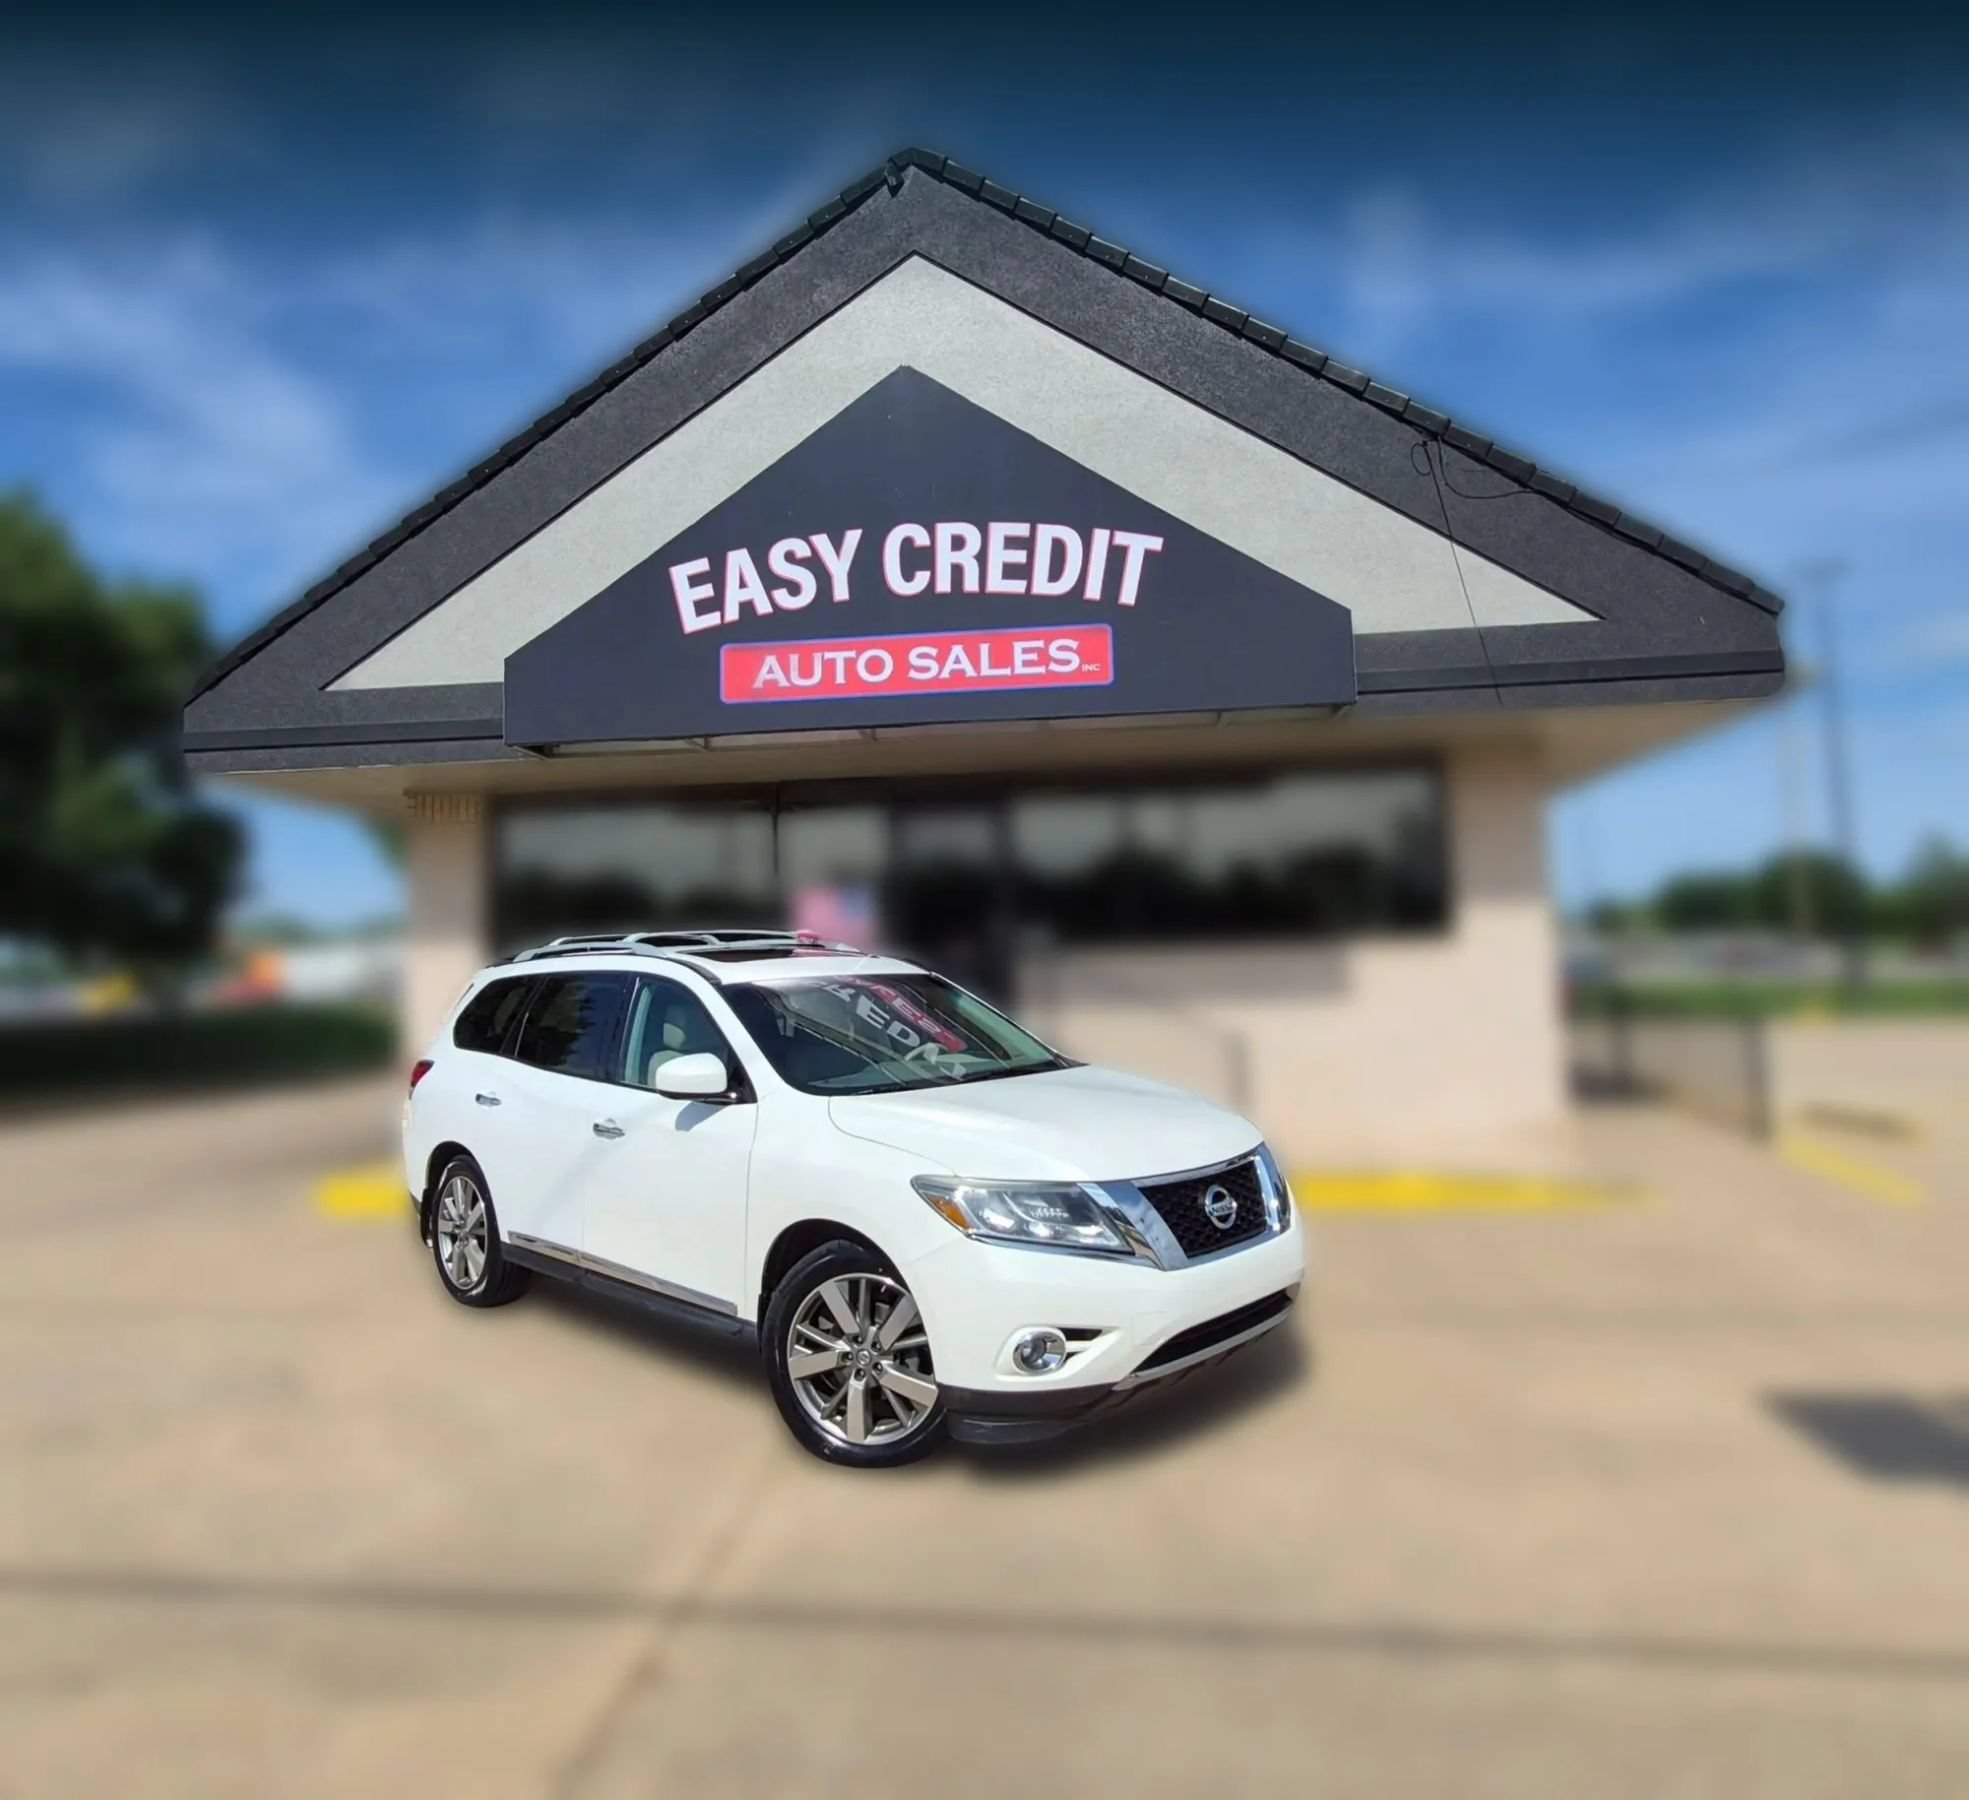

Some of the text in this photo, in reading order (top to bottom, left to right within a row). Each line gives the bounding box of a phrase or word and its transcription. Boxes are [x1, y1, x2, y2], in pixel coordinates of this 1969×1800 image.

[668, 521, 1164, 634] EASY CREDIT
[752, 638, 1101, 689] AUTO SALES INC
